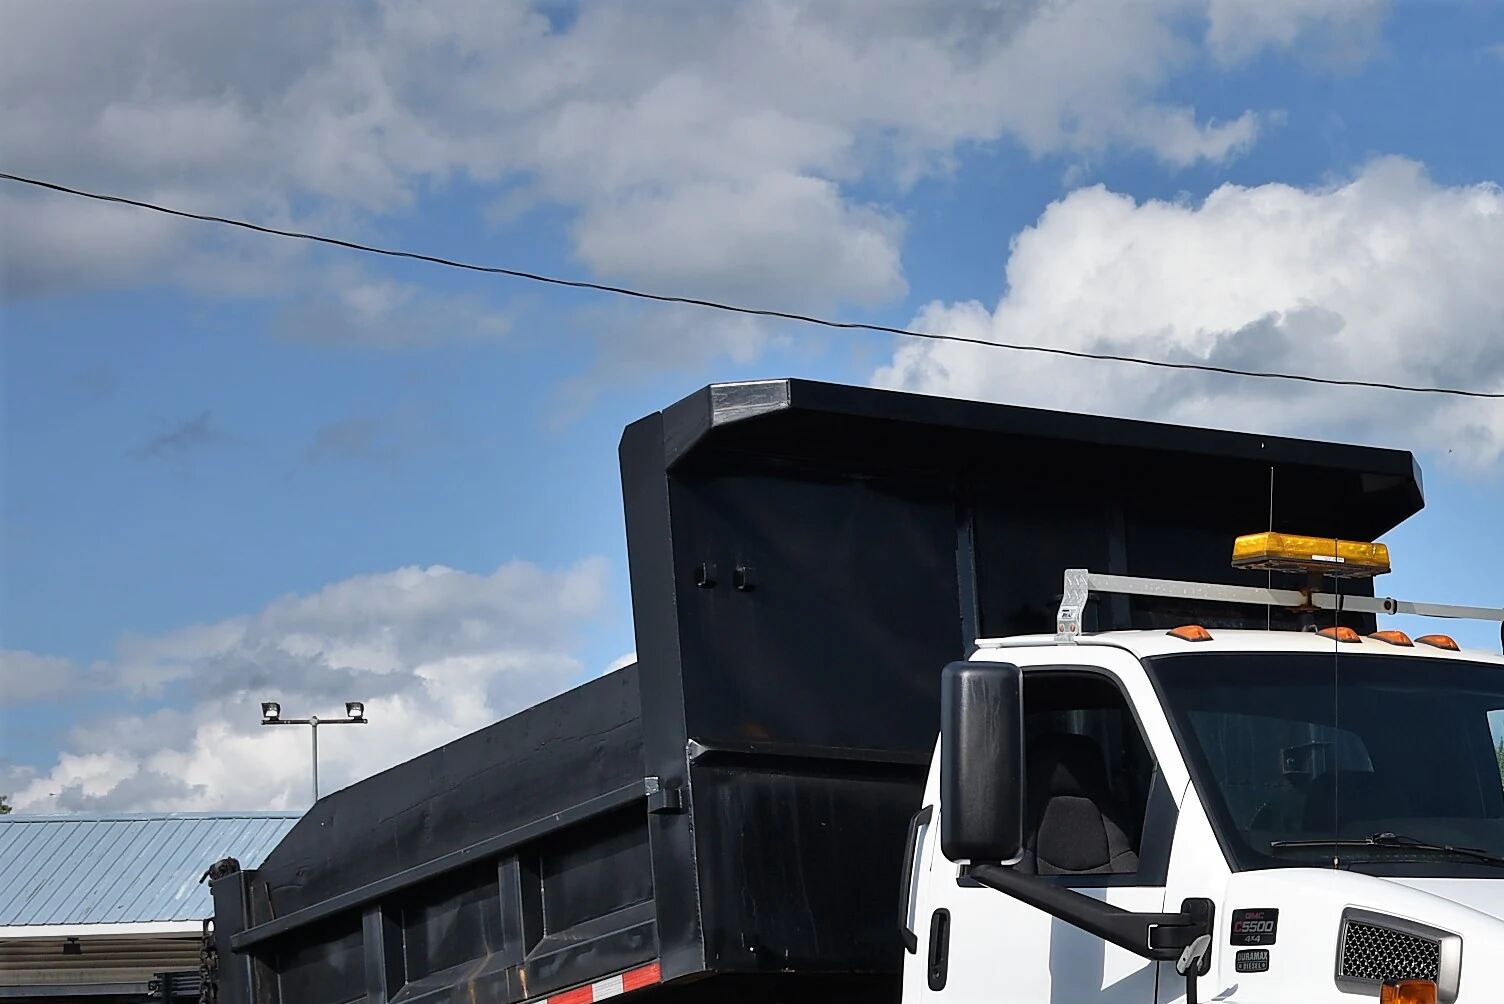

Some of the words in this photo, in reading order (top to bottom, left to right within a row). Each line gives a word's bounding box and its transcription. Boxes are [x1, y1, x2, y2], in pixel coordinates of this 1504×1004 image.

[1245, 912, 1265, 920] GMC
[1232, 920, 1274, 933] C5500
[1237, 951, 1269, 961] DURAMAX
[1243, 962, 1262, 970] DIESEL
